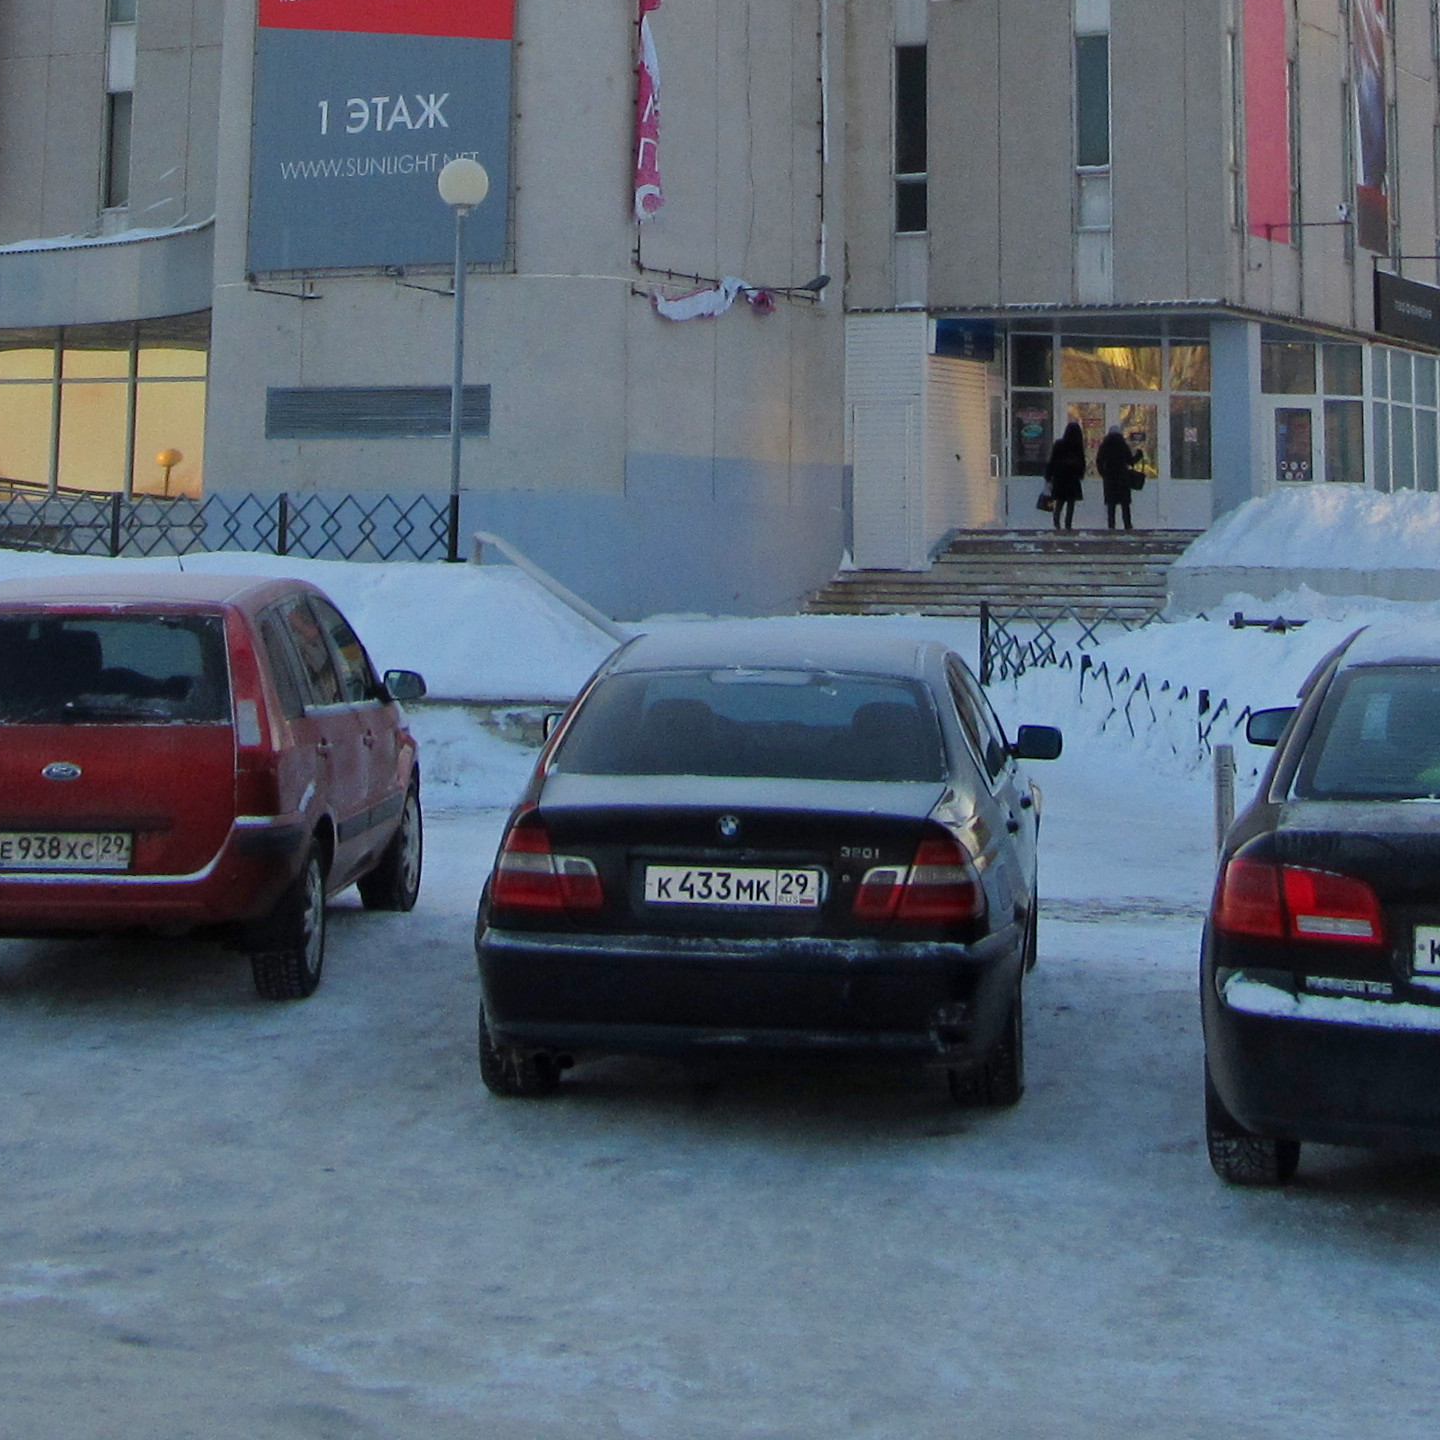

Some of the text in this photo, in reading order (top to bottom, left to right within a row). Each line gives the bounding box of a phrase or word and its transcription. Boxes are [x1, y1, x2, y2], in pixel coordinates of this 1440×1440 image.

[317, 92, 450, 135] 1 ЭТАЖ
[101, 835, 125, 854] 29
[780, 873, 809, 895] 29
